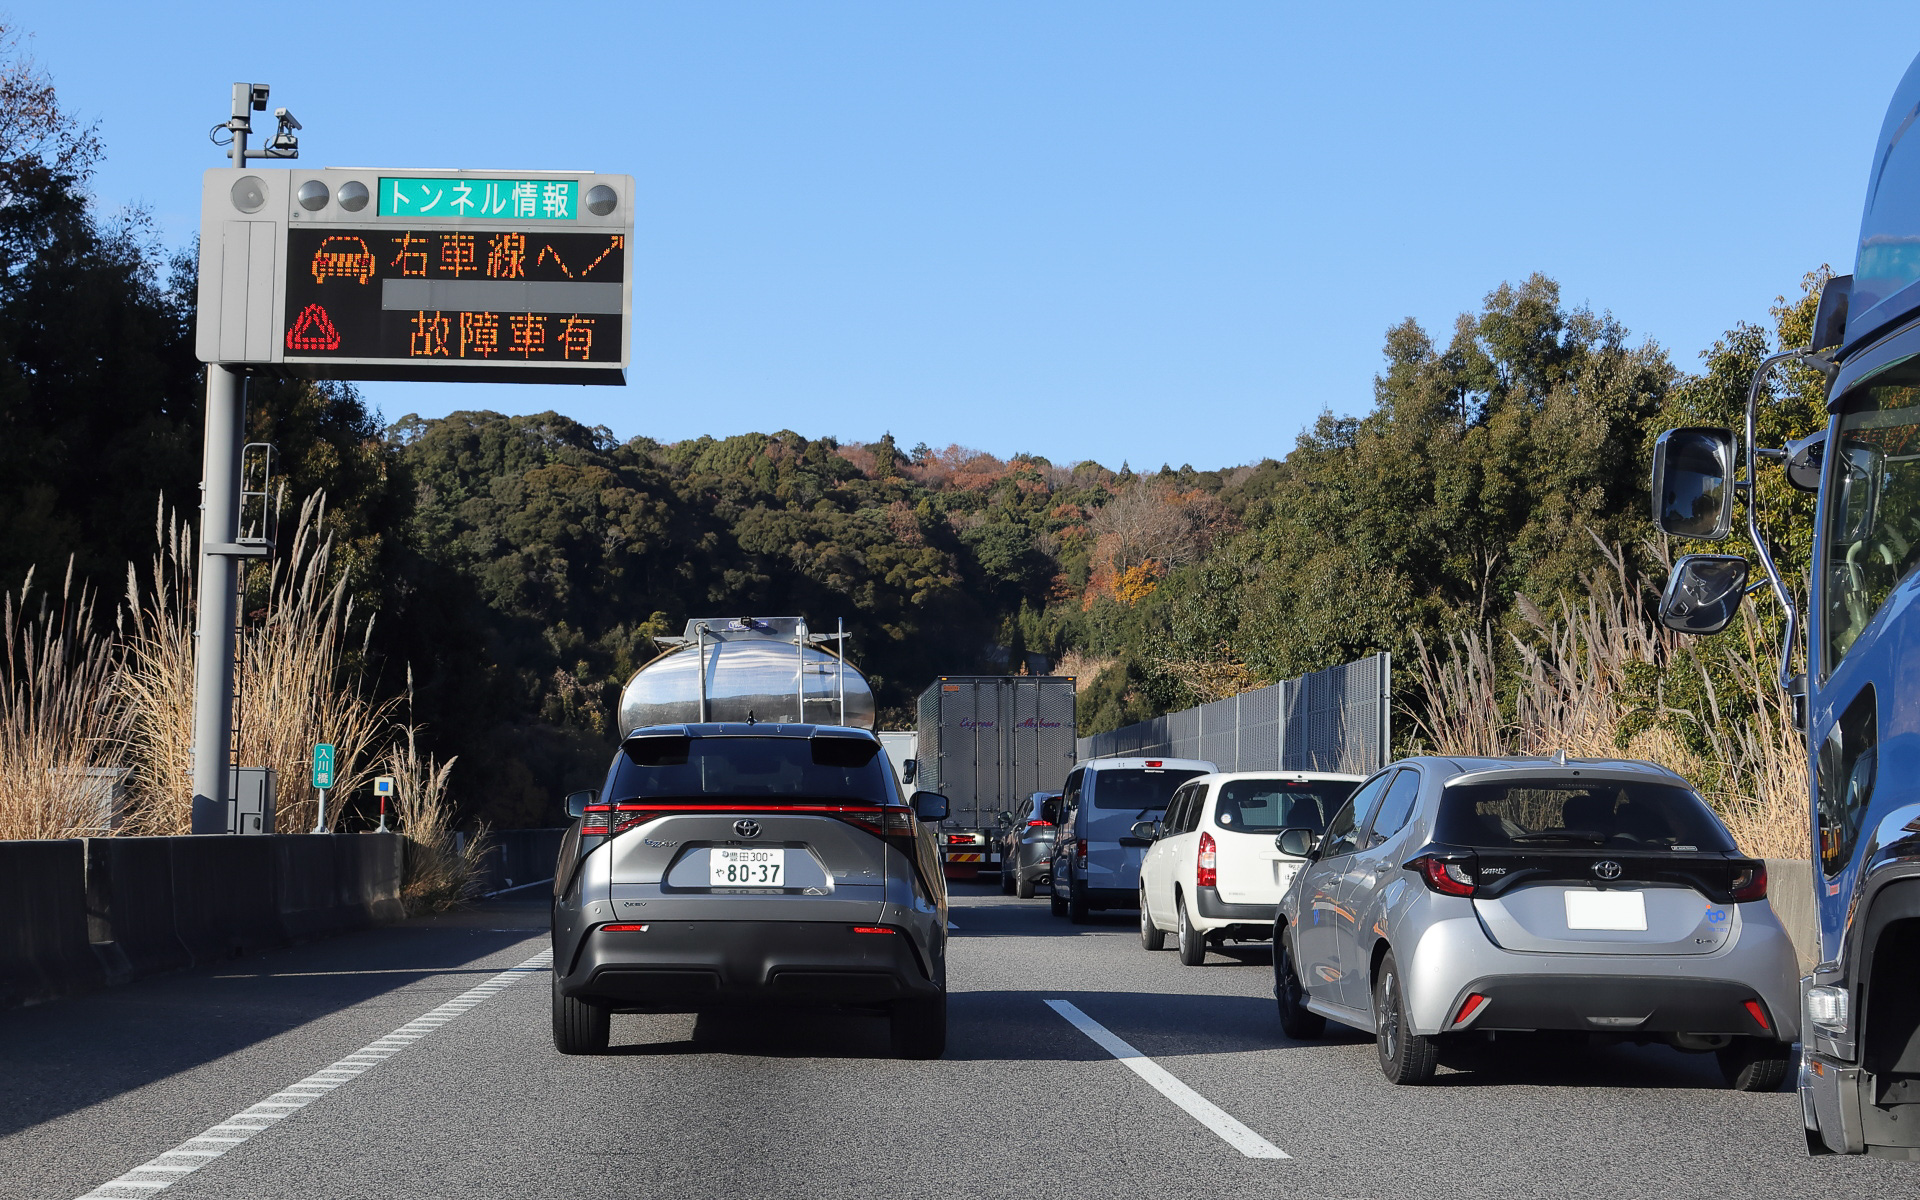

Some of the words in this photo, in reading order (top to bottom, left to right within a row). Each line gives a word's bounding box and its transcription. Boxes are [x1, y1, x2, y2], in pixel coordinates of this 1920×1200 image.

[392, 180, 569, 218] トンネル情報
[391, 230, 573, 279] 右車線へ
[410, 310, 596, 360] 故障車有
[960, 717, 994, 730] Express
[317, 748, 330, 784] 入川橋
[750, 852, 768, 862] 300
[727, 864, 780, 883] 80-37
[1481, 867, 1507, 875] YARIS
